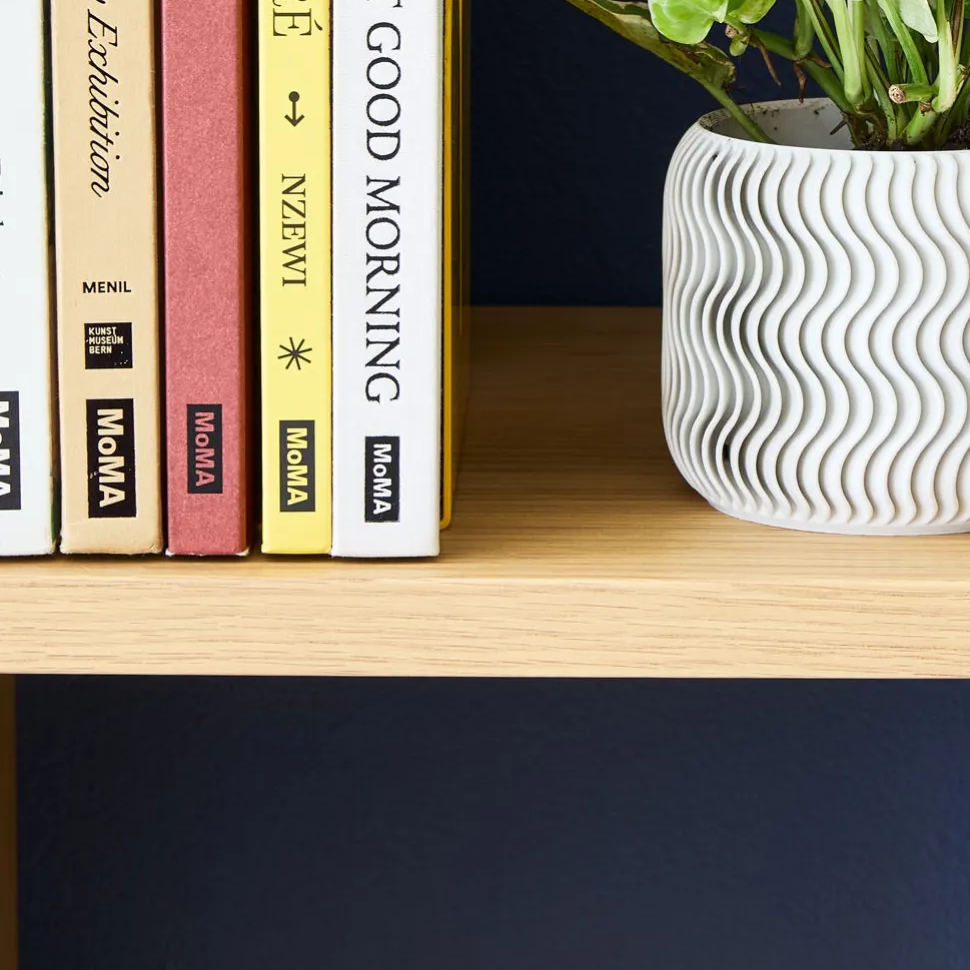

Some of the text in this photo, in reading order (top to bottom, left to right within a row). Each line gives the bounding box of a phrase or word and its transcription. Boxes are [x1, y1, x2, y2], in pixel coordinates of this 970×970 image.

[87, 8, 121, 198] Exhibition
[365, 21, 402, 161] GOOD
[281, 173, 307, 287] NZEWI
[82, 280, 132, 294] MENIL
[364, 175, 401, 403] MORNING
[88, 326, 117, 336] KUNST
[88, 335, 124, 345] MUSEUM
[88, 345, 113, 354] BERN
[96, 408, 126, 508] MoMA
[194, 411, 215, 487] MoMA
[286, 427, 308, 506] MoMA
[372, 443, 392, 515] MoMA
